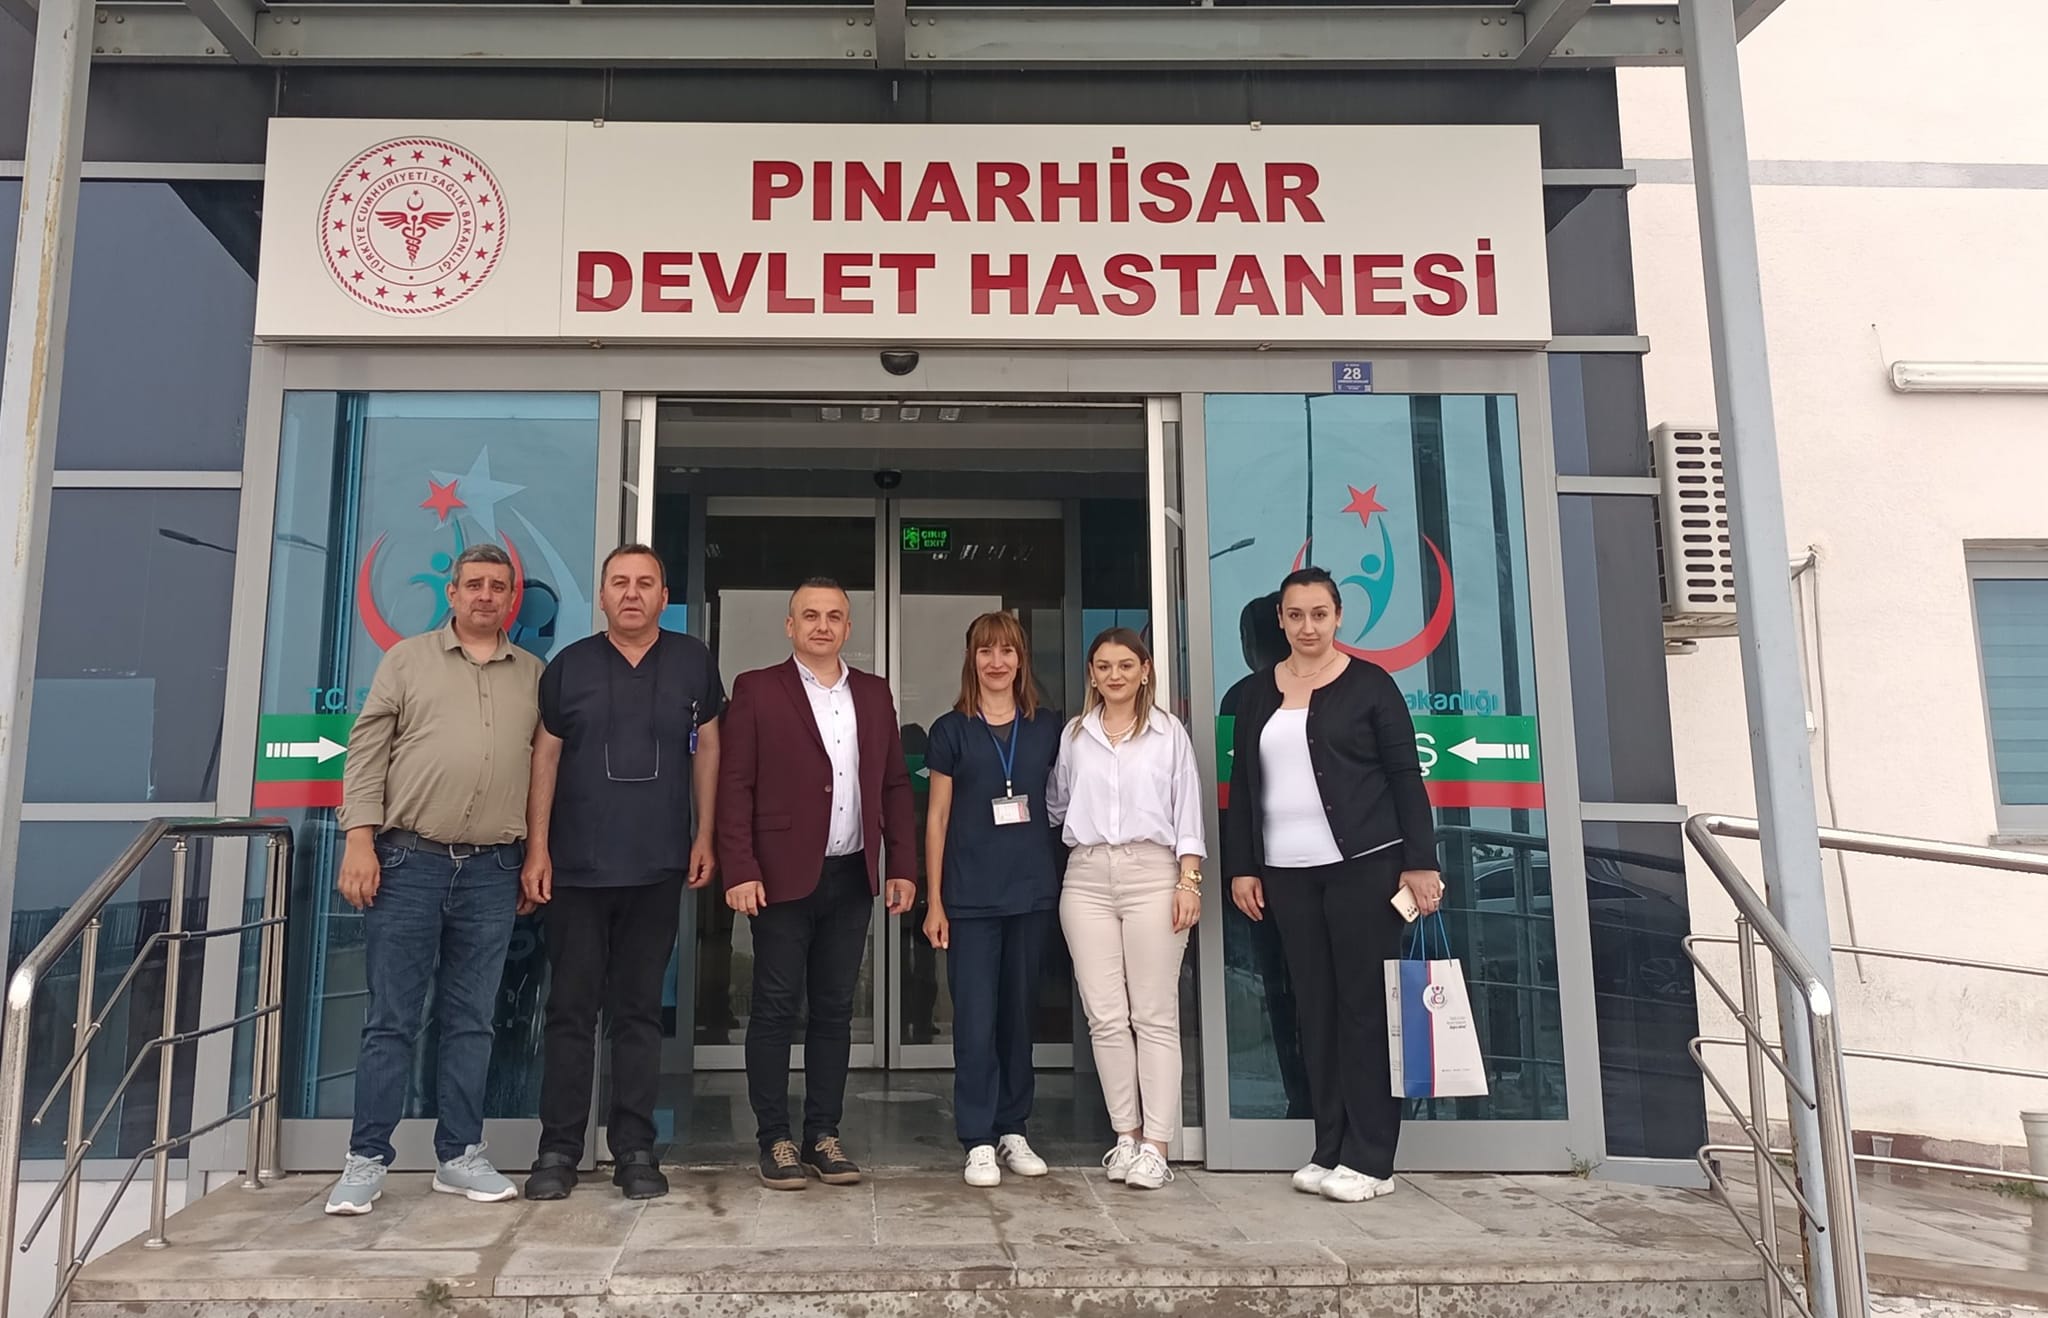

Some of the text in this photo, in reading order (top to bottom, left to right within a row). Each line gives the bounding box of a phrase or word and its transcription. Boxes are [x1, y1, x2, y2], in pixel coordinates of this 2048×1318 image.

[752, 146, 1325, 223] PINARHİSAR
[356, 171, 472, 274] TÜRKİYE CUMHURİYETİ SAĞLIK BAKANLIĞI
[576, 238, 1499, 316] DEVLET HASTANESİ
[1343, 367, 1362, 380] 28
[924, 539, 946, 547] EXIT
[1404, 689, 1499, 717] akanlığı
